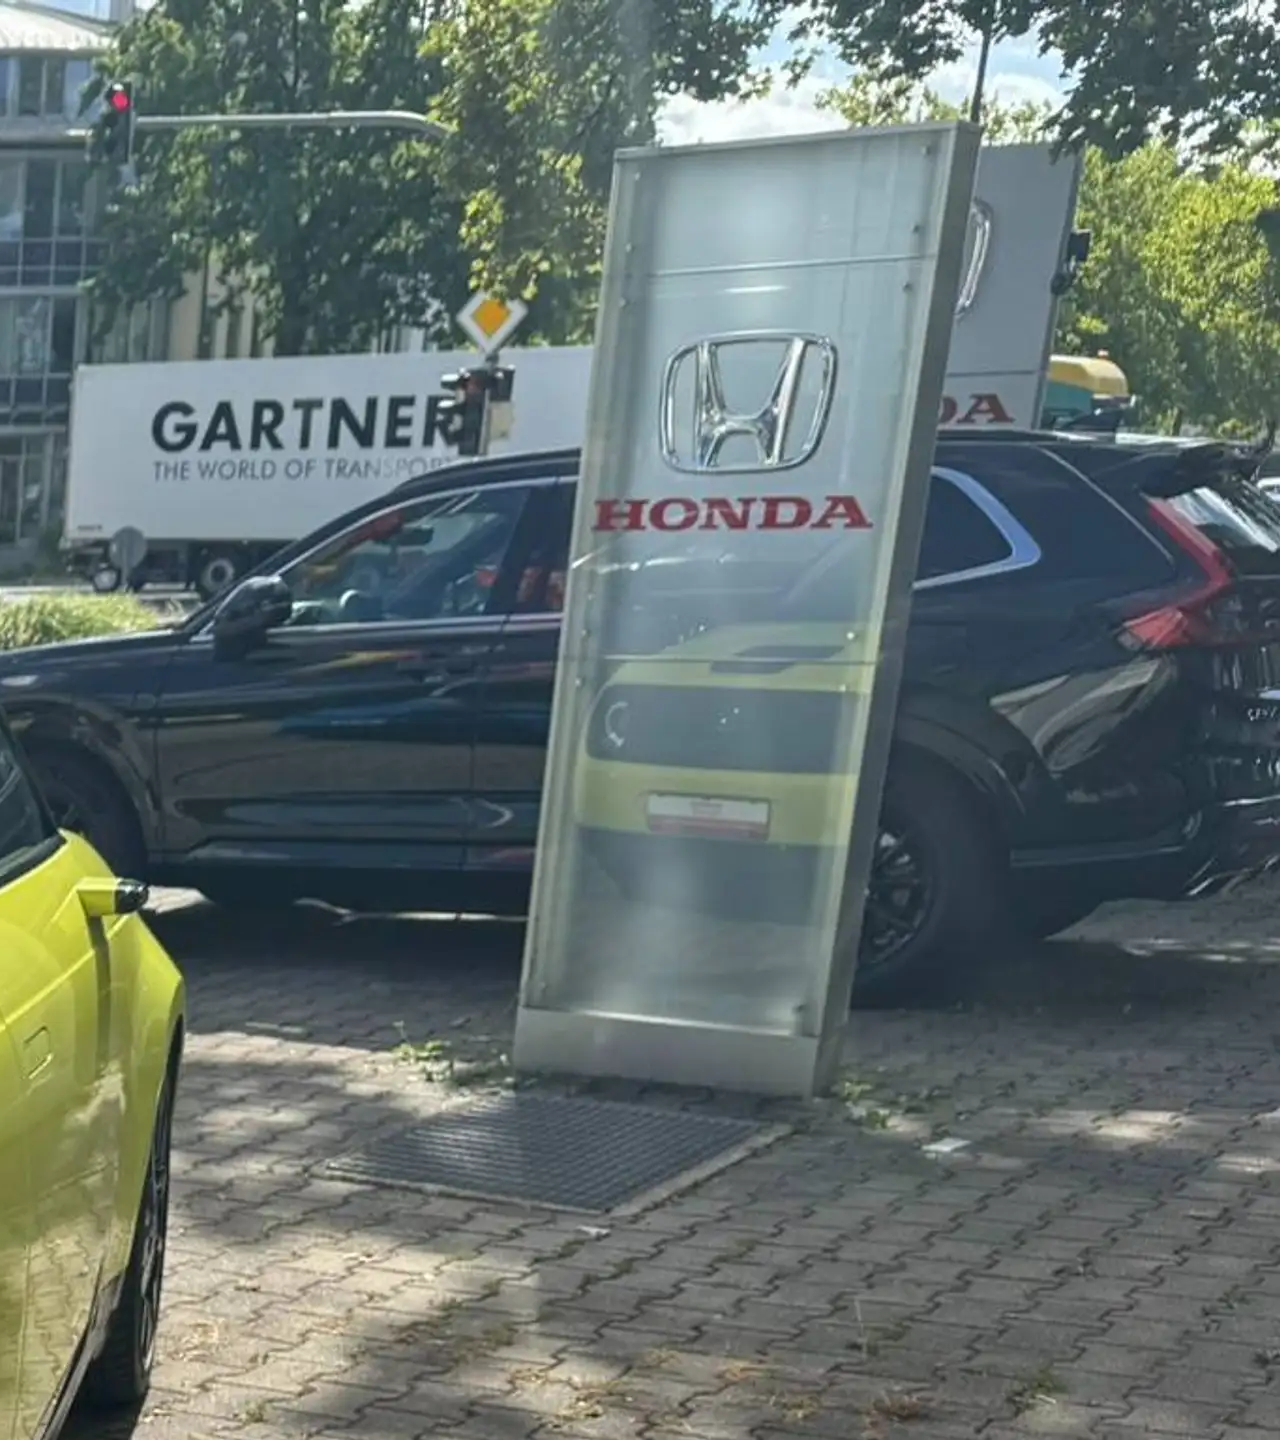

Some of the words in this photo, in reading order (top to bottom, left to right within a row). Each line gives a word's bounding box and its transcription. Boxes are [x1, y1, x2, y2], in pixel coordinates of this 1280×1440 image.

[151, 395, 458, 452] GARTNER
[153, 460, 190, 481] THE
[197, 459, 277, 480] WORLD
[285, 458, 317, 480] OF
[325, 456, 453, 480] TRANSPOR
[592, 495, 874, 532] HONDA
